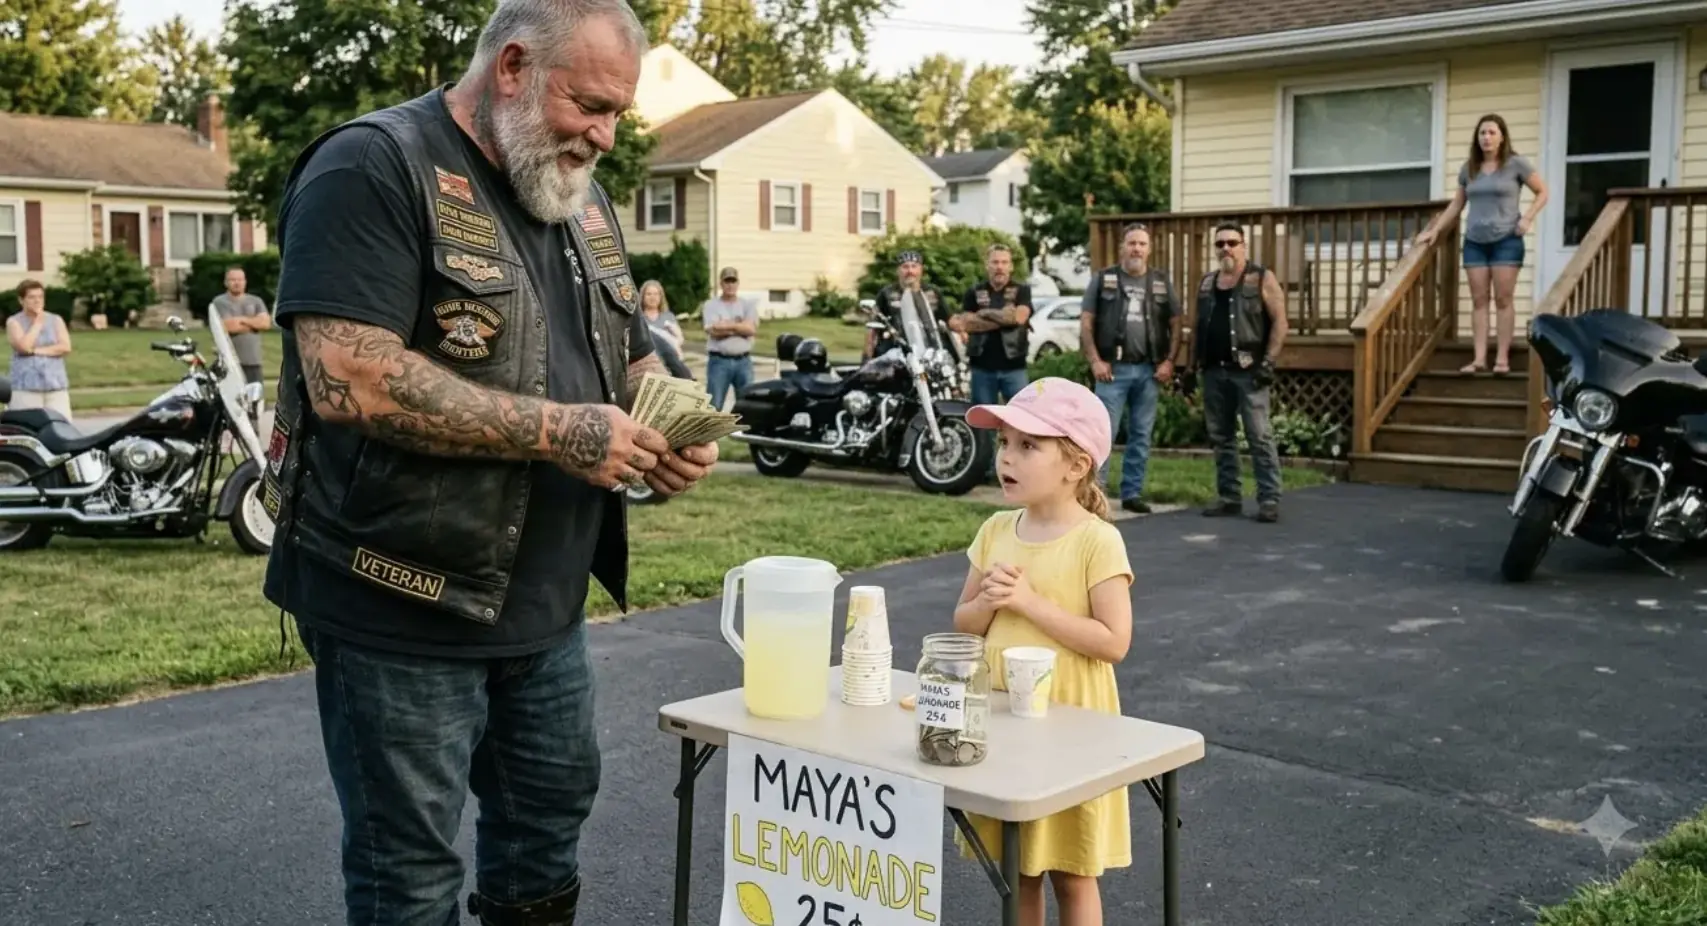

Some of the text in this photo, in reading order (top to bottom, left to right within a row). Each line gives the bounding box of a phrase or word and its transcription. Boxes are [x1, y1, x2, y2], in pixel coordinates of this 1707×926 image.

[361, 553, 439, 595] VETERAN
[754, 753, 896, 839] MAYA'S
[732, 813, 936, 922] LEMONADE
